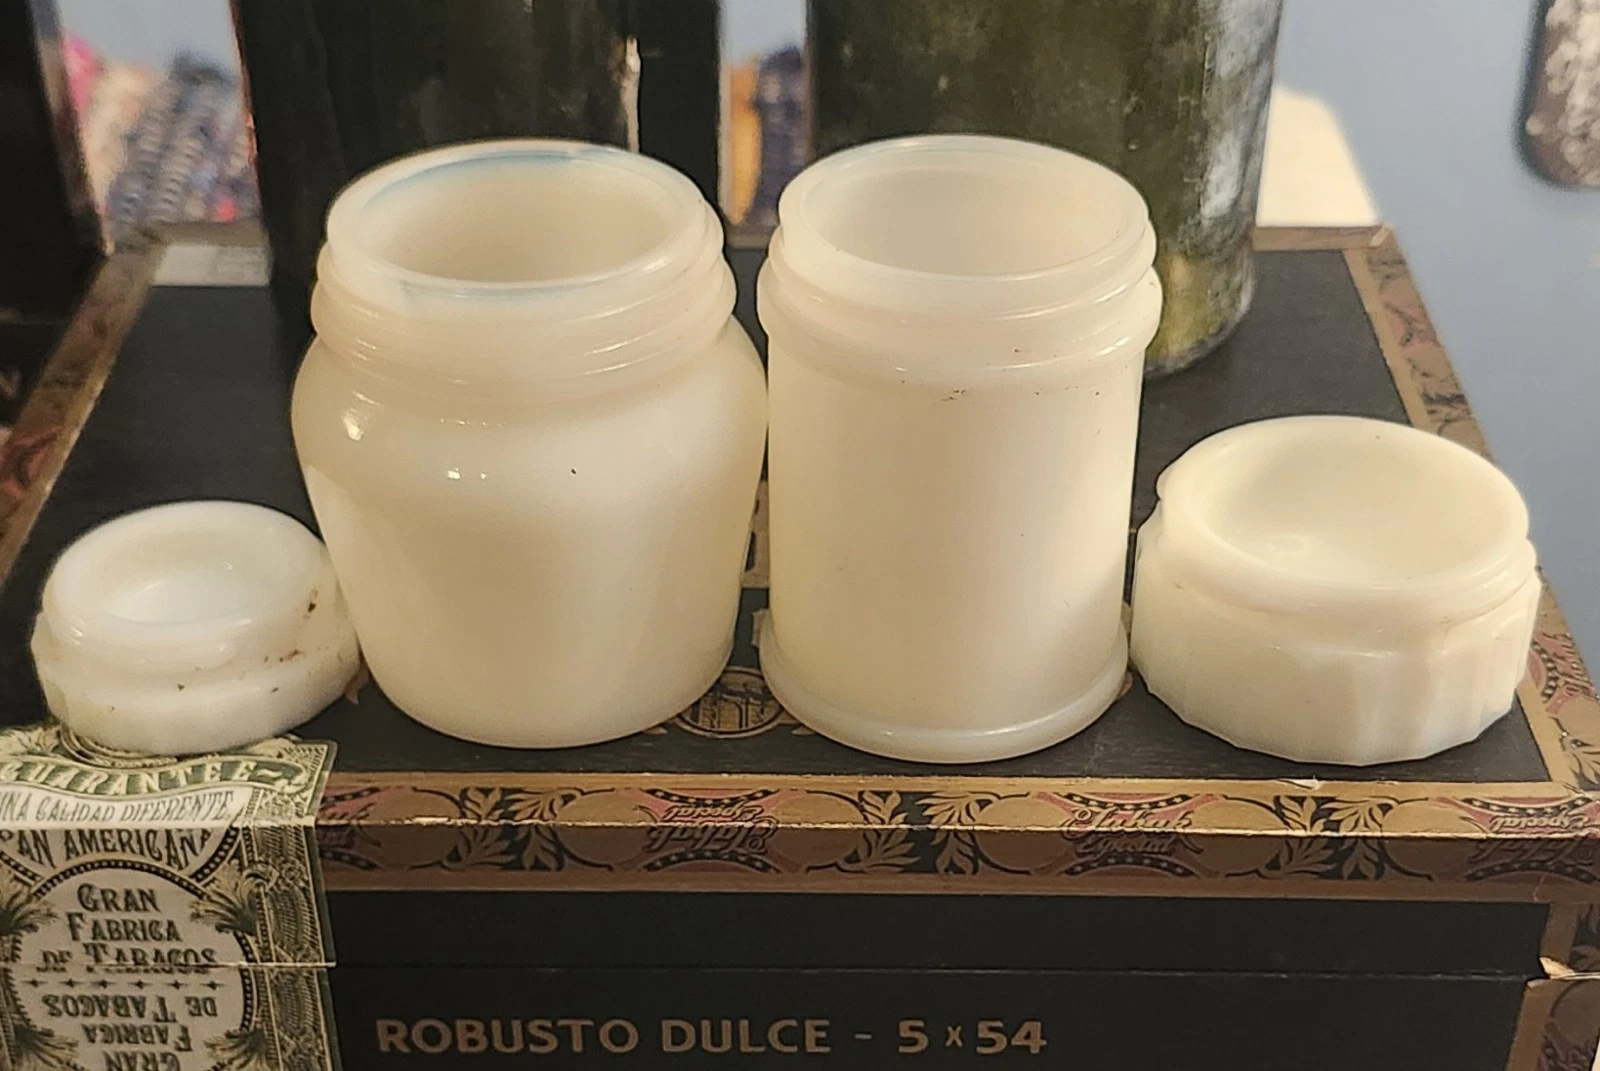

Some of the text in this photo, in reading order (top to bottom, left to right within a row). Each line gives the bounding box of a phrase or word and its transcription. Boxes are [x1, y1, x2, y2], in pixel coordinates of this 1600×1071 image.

[0, 760, 257, 794] GUARANTEE
[36, 796, 116, 822] CALIDAD
[77, 883, 160, 913] GRAN
[66, 911, 183, 942] FABRICA
[36, 942, 217, 974] DE TABACOS
[42, 994, 218, 1024] DE TABACOS
[81, 1023, 193, 1052] FABRICA
[375, 1018, 640, 1053] ROBUSTO
[661, 1018, 831, 1053] DULCE
[898, 1019, 929, 1054] 5
[976, 1019, 1048, 1054] 54
